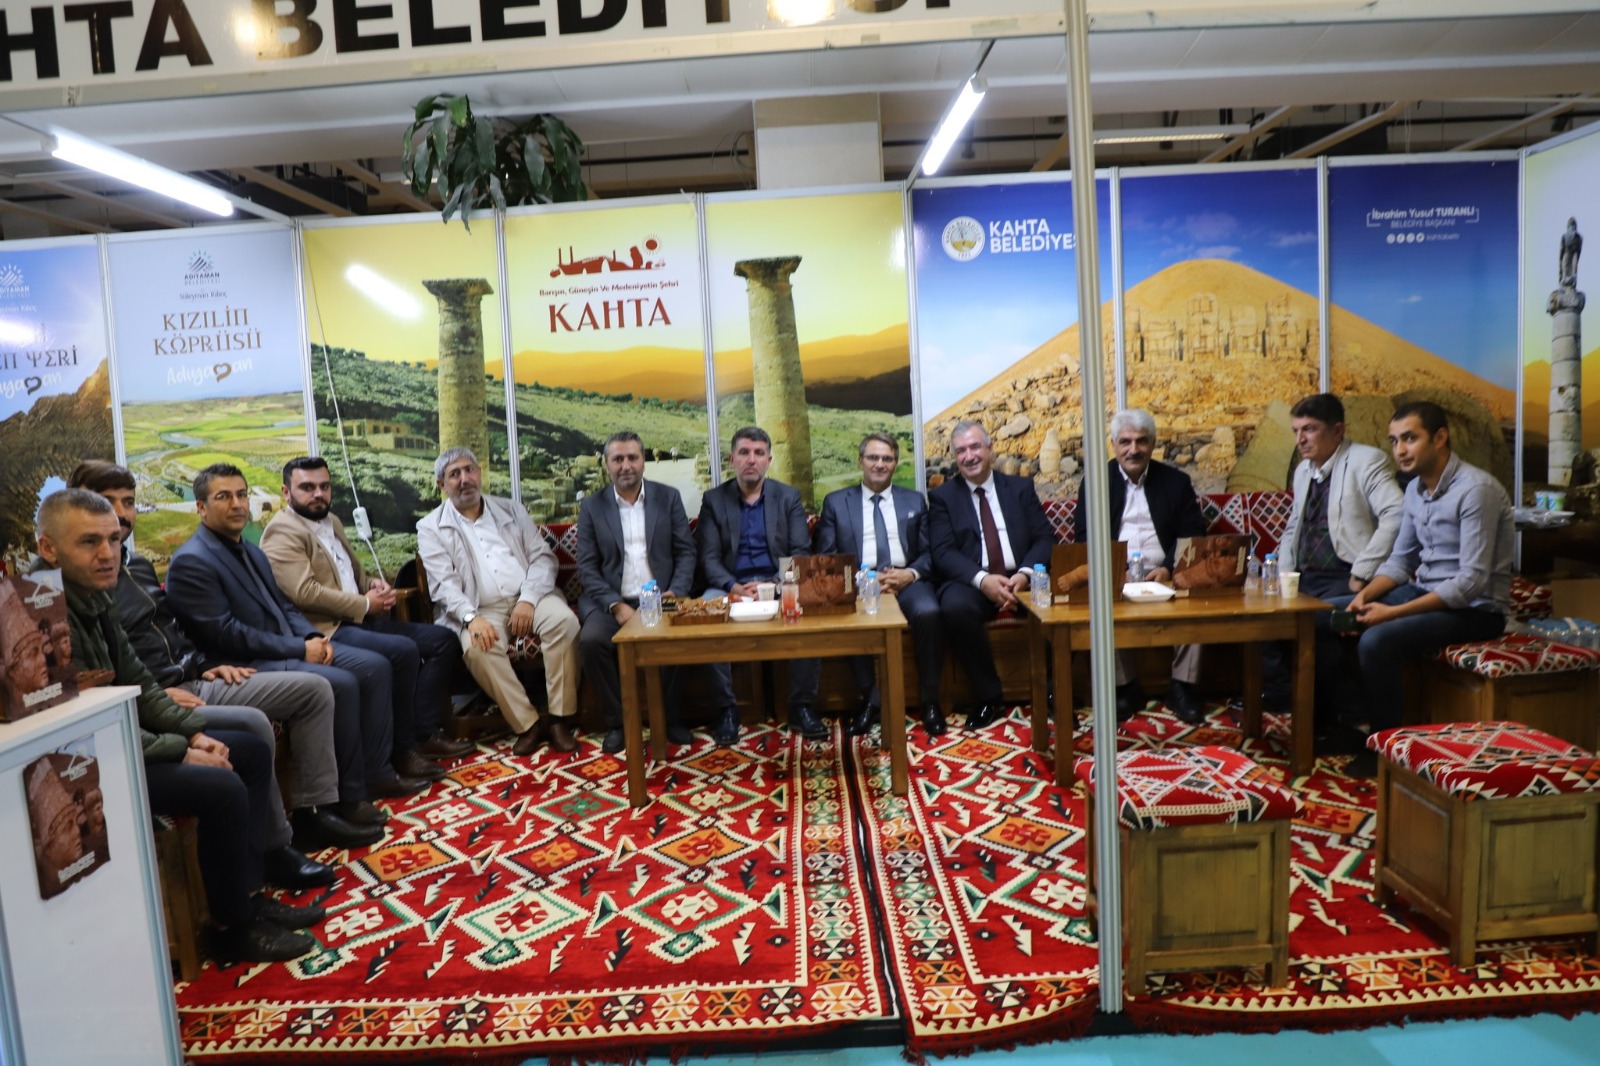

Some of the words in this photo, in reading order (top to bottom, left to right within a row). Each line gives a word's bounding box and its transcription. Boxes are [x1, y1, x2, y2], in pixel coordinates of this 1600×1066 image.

[989, 218, 1050, 237] KAHTA
[990, 232, 1077, 254] BELEDİYE
[548, 296, 672, 333] KAHTA
